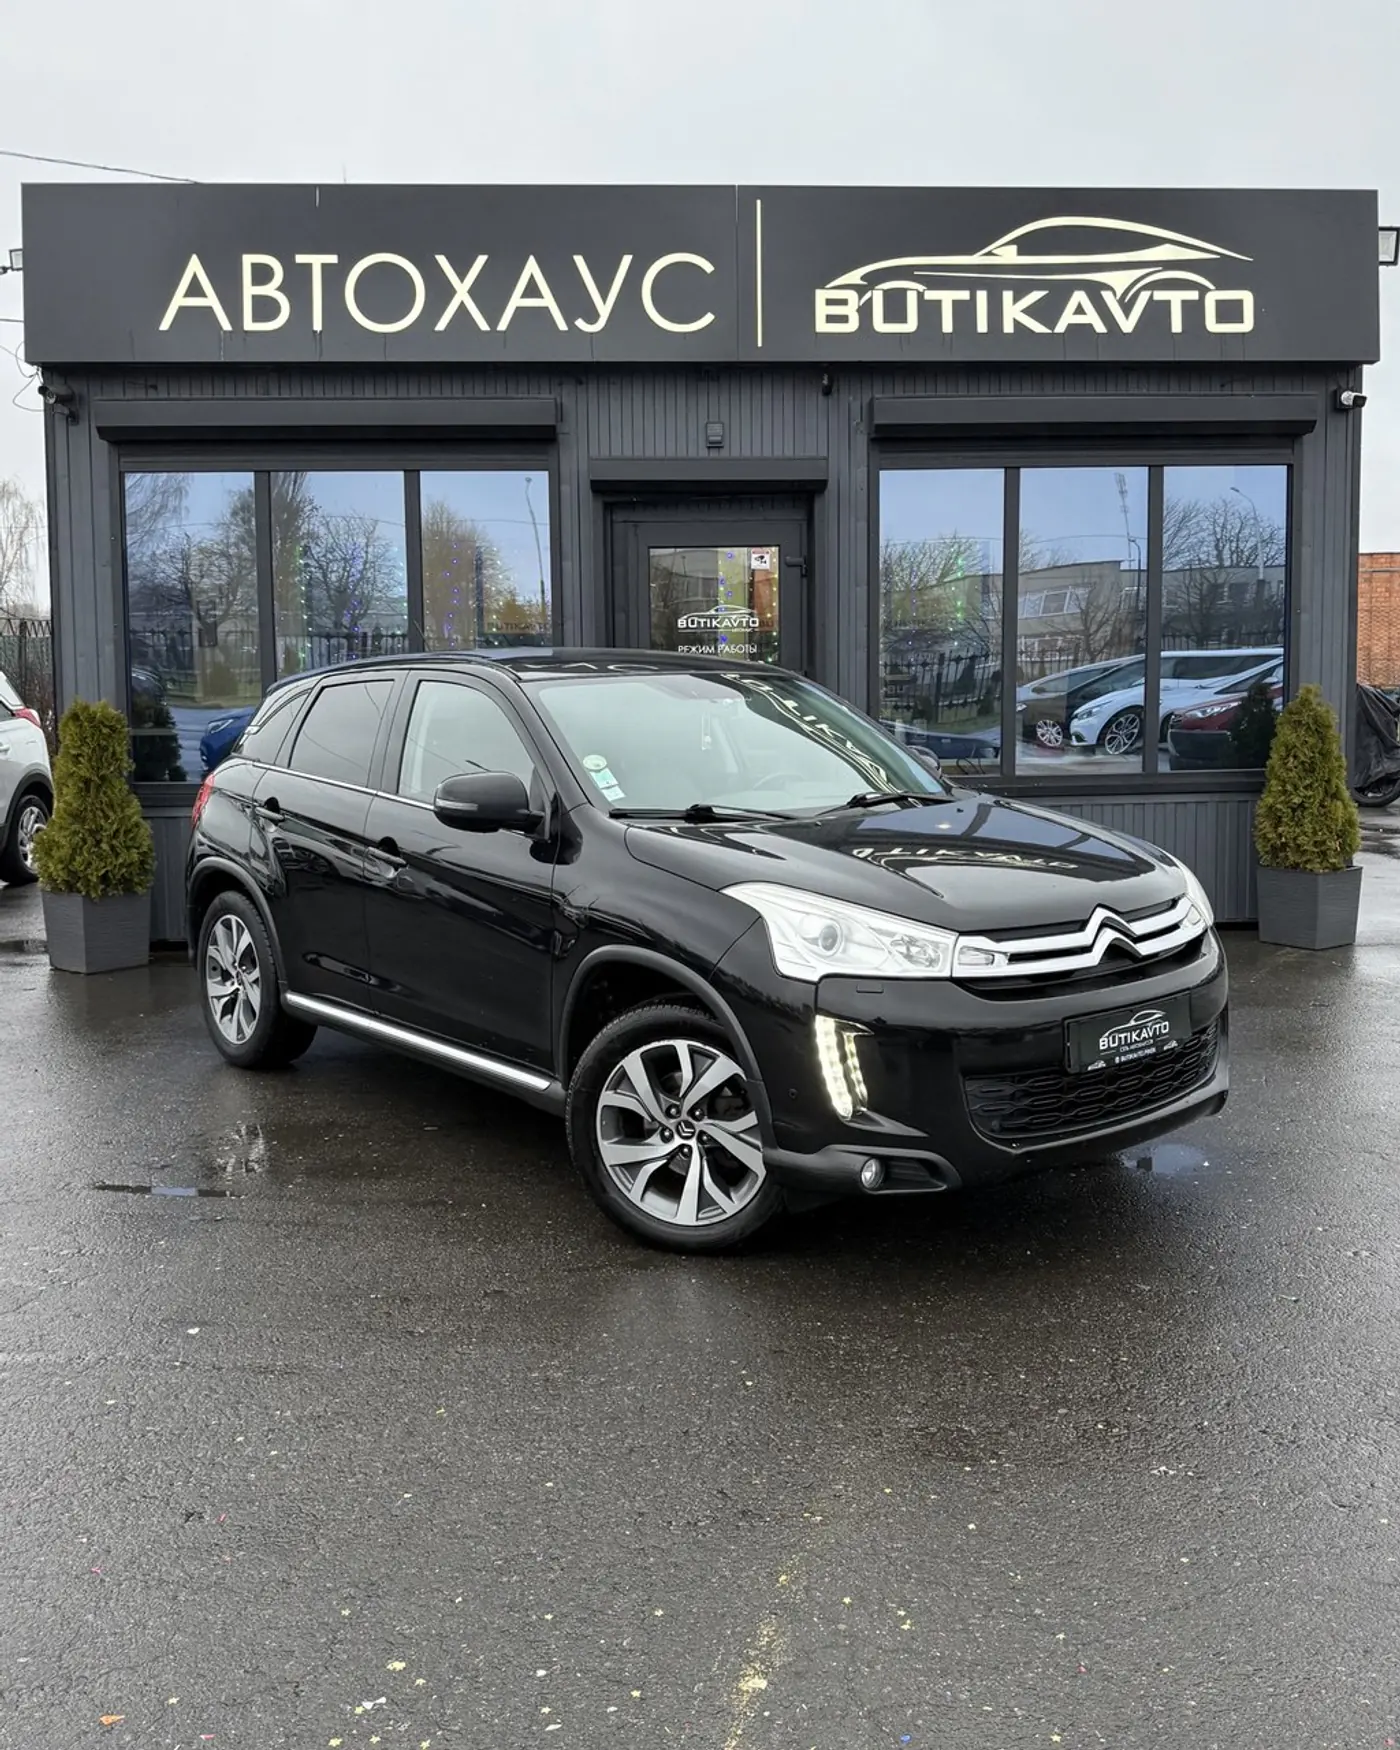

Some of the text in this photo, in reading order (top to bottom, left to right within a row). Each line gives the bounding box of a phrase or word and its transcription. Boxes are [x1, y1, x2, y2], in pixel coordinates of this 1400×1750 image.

[159, 253, 715, 334] АВТОХАУС
[815, 288, 1254, 334] BUTIKAVTO
[677, 617, 760, 629] BUTIKAVTO
[677, 644, 758, 654] РЕЖИМ РАБОТЫ
[1099, 1021, 1169, 1050] BUTIKAVTO
